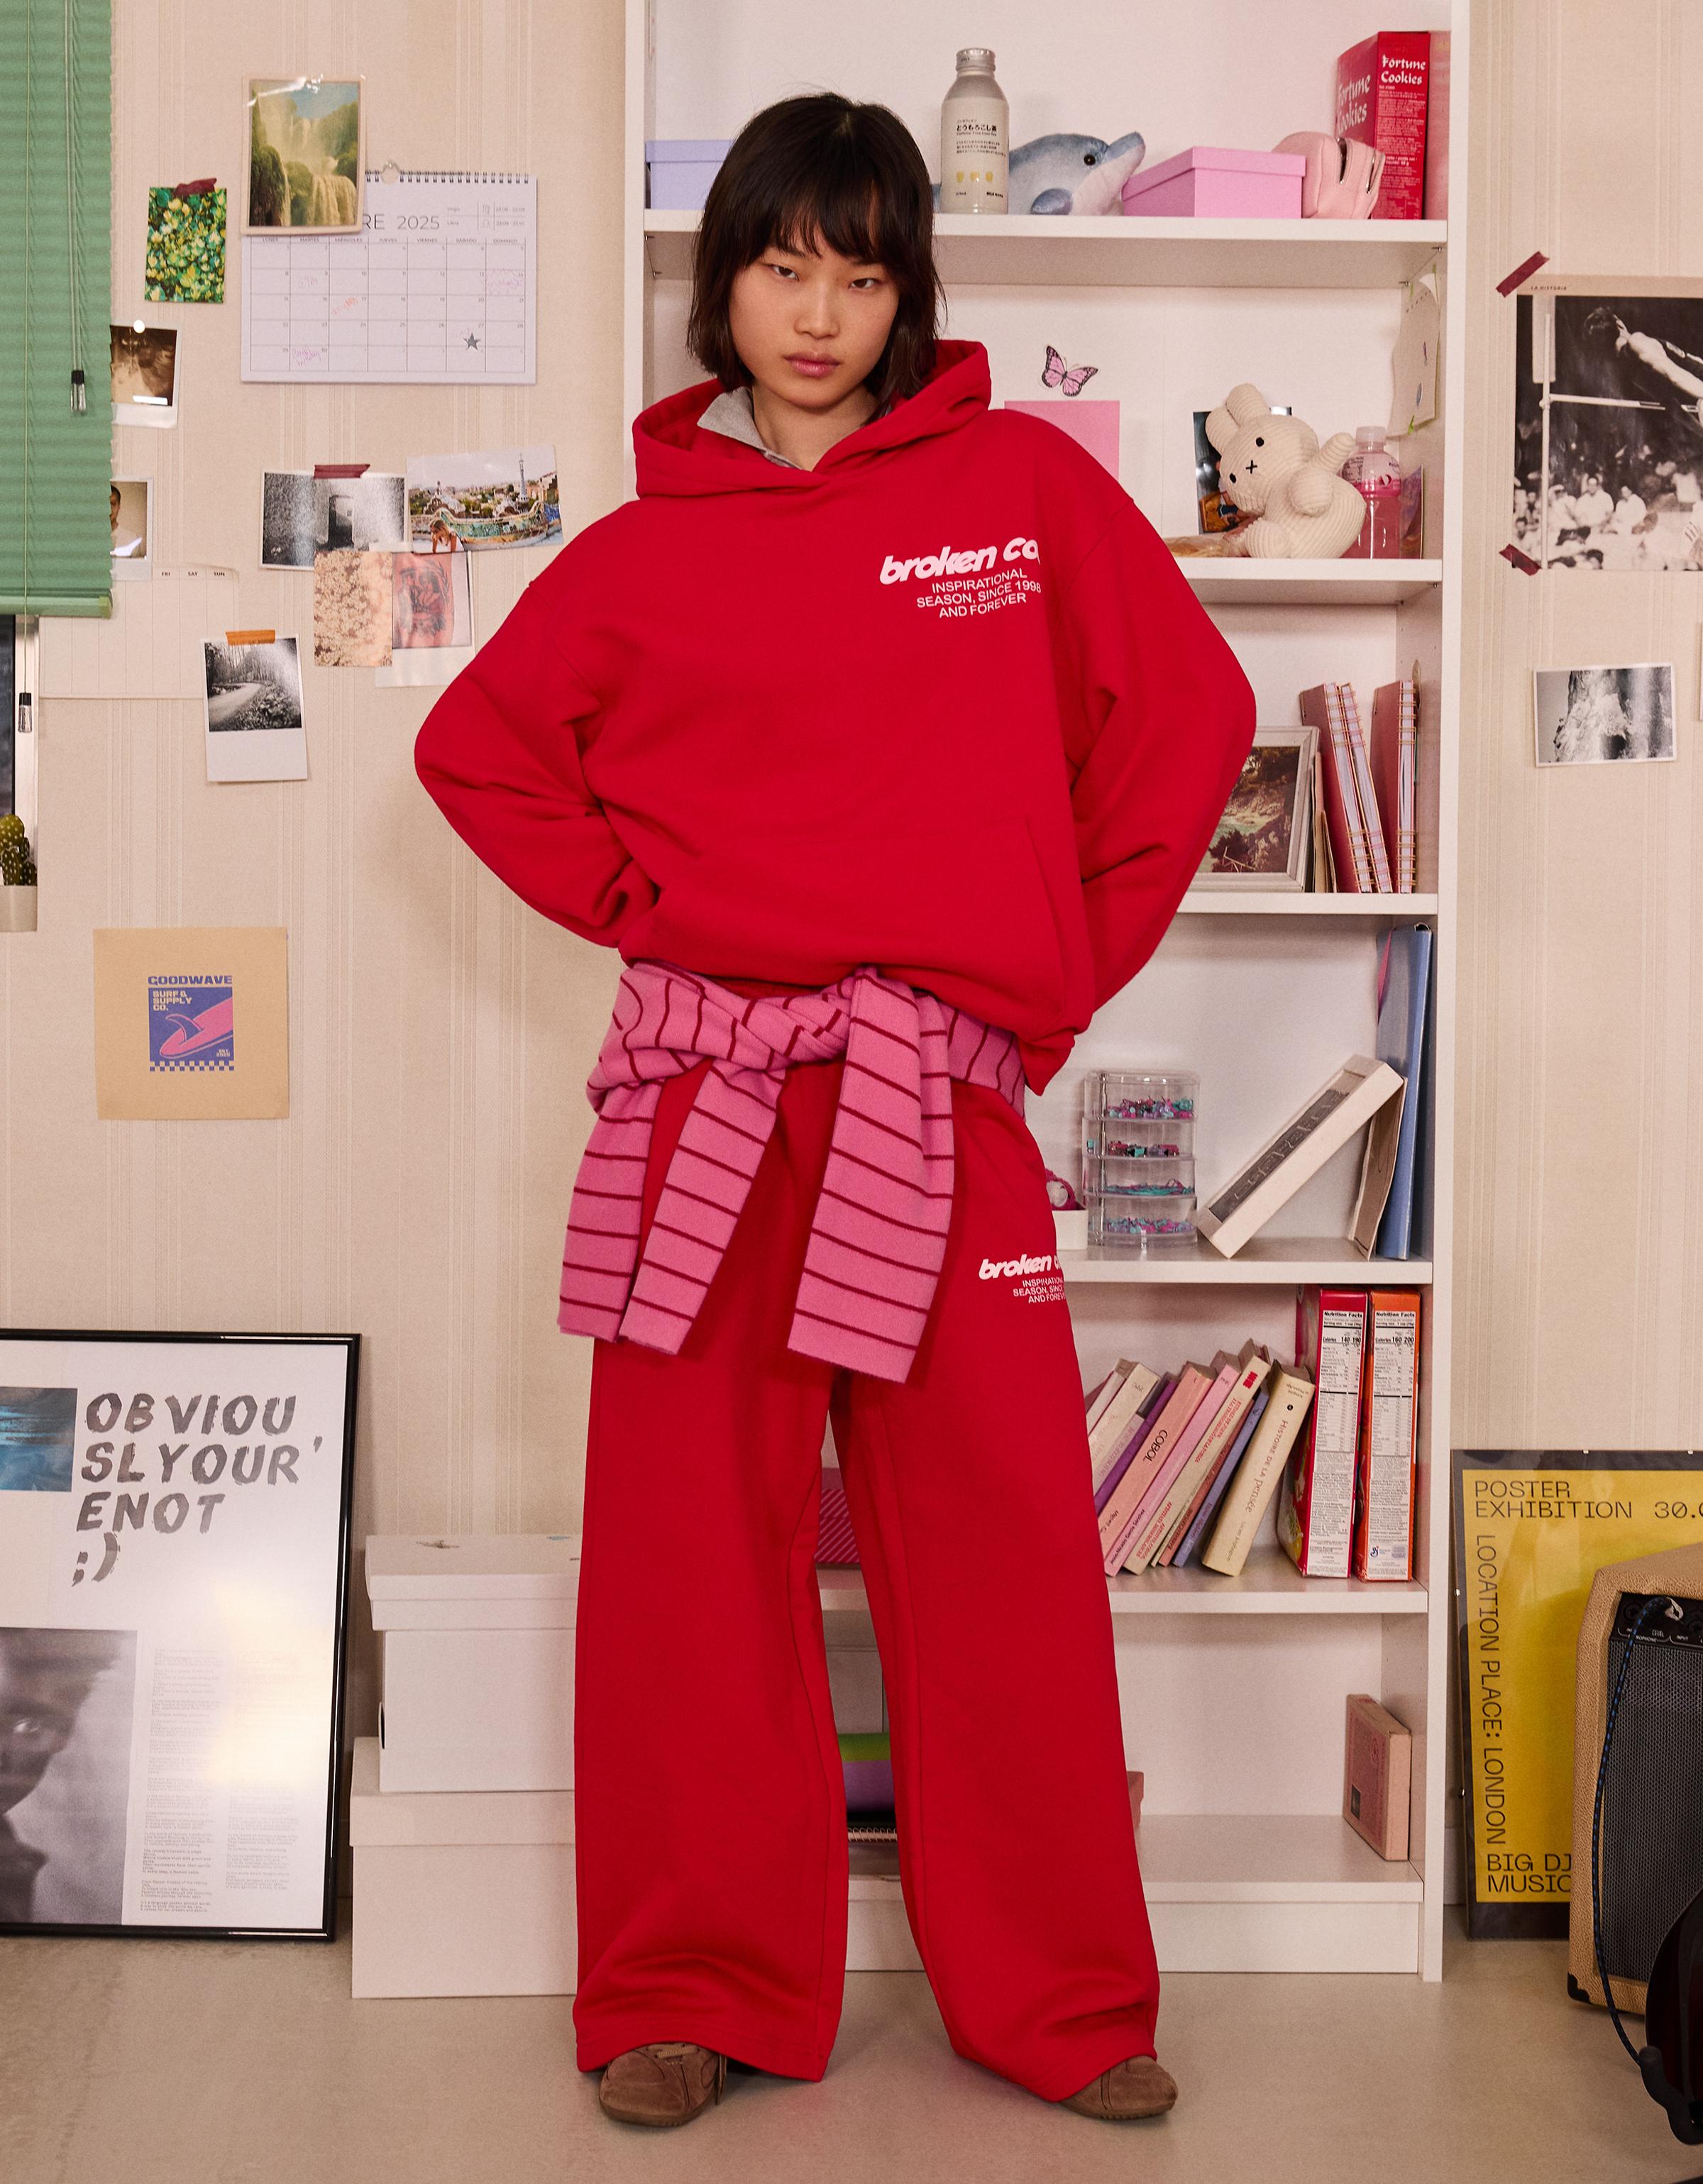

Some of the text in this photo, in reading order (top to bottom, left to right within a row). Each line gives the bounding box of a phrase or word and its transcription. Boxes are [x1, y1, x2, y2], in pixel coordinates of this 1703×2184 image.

[1382, 55, 1426, 70] Fortune
[1381, 71, 1423, 85] Cookies
[397, 215, 440, 230] 2025
[879, 545, 998, 585] broken
[932, 568, 1027, 594] INSPIRATIONAL
[917, 580, 1042, 609] SEASON, SINCE 1998
[939, 592, 1027, 619] AND FOREVER
[148, 976, 233, 986] GOODWAVE
[979, 1254, 1052, 1280] broken
[1013, 1286, 1049, 1297] SEASON,
[1028, 1294, 1046, 1304] AND
[1142, 1429, 1168, 1462] COBOL
[1242, 1418, 1289, 1513] HISTOIRE DE LA pensée
[1475, 1481, 1570, 1498] POSTER
[76, 1491, 226, 1533] ENOT
[1476, 1501, 1632, 1519] EXHIBITION
[1477, 1535, 1506, 1844] LOCATION PLACE: LONDON
[1487, 1853, 1533, 1872] BIG
[1487, 1875, 1571, 1893] MUSIC
